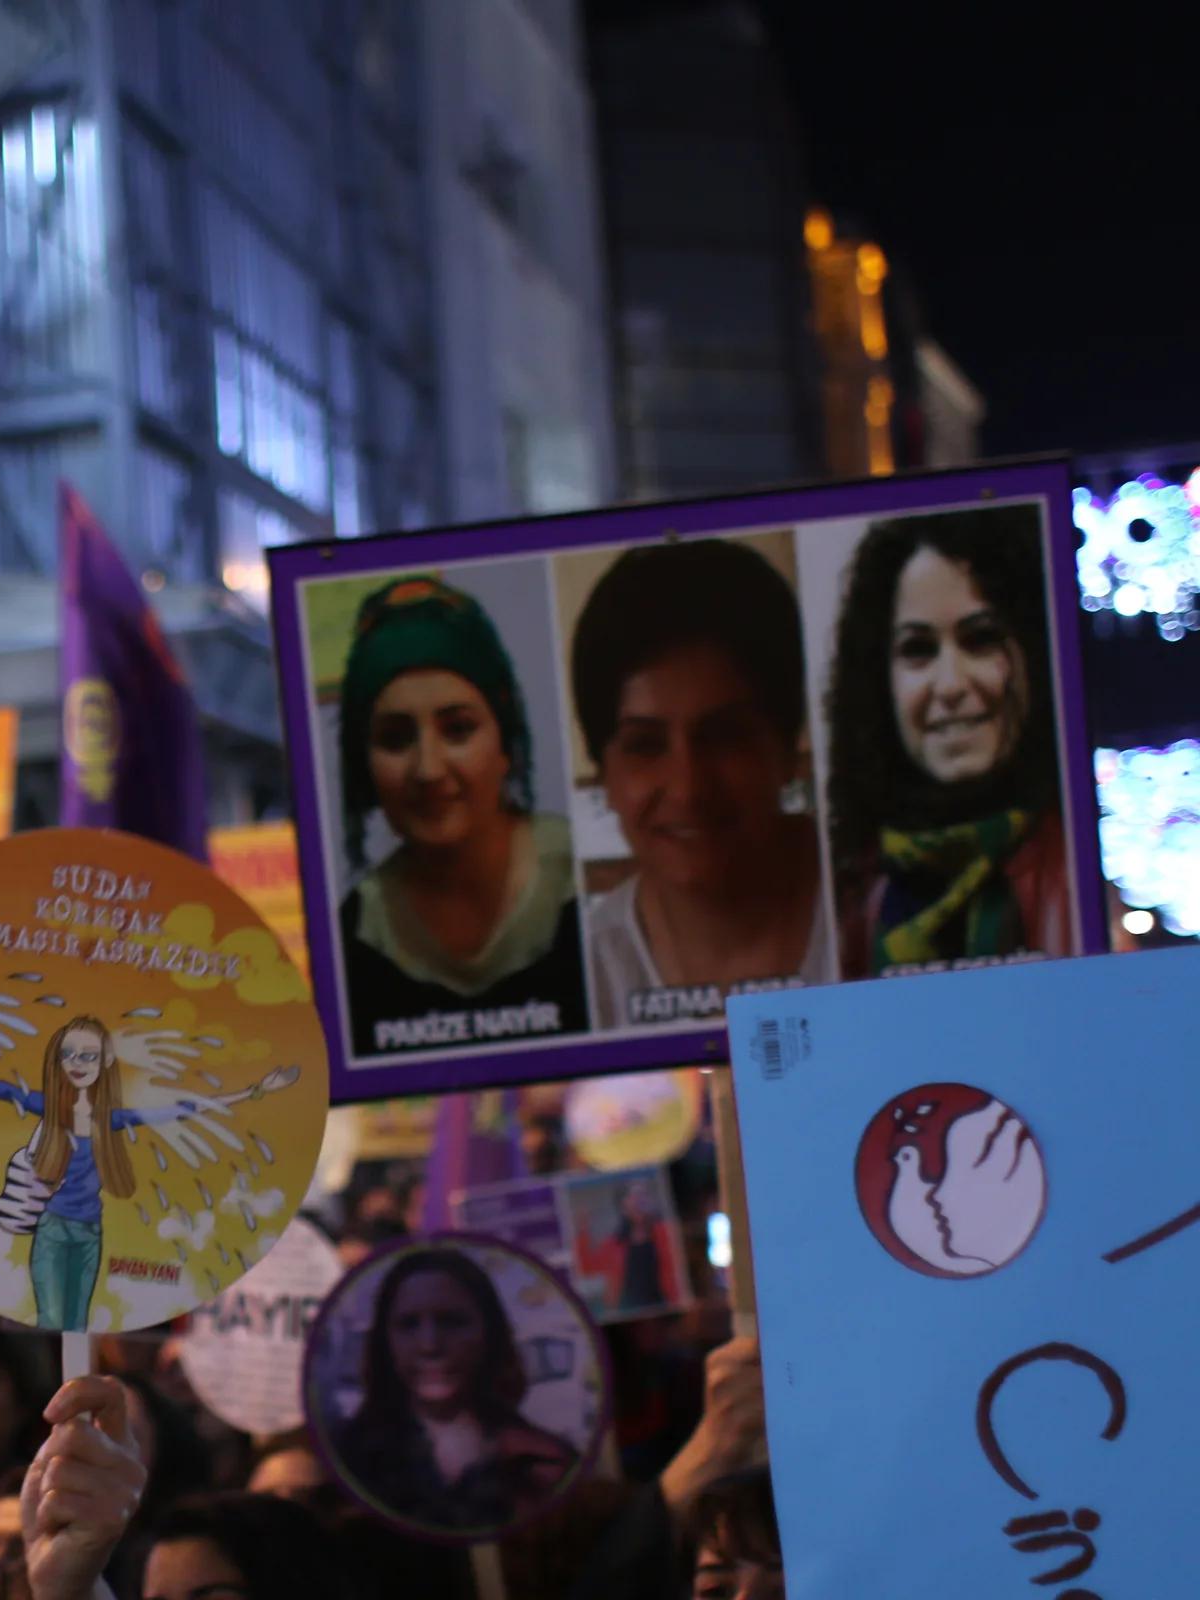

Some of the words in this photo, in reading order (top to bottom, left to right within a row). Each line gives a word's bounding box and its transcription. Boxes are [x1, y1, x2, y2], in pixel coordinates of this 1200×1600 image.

[52, 864, 153, 901] SUDAN
[33, 895, 163, 935] KORKSAK
[85, 937, 240, 978] ASMAZDIK
[630, 986, 722, 1020] FATMA
[374, 1009, 473, 1049] PAKİZE
[107, 1256, 148, 1277] BAYAN
[150, 1263, 181, 1284] YANI
[975, 1341, 1129, 1600] Cin
